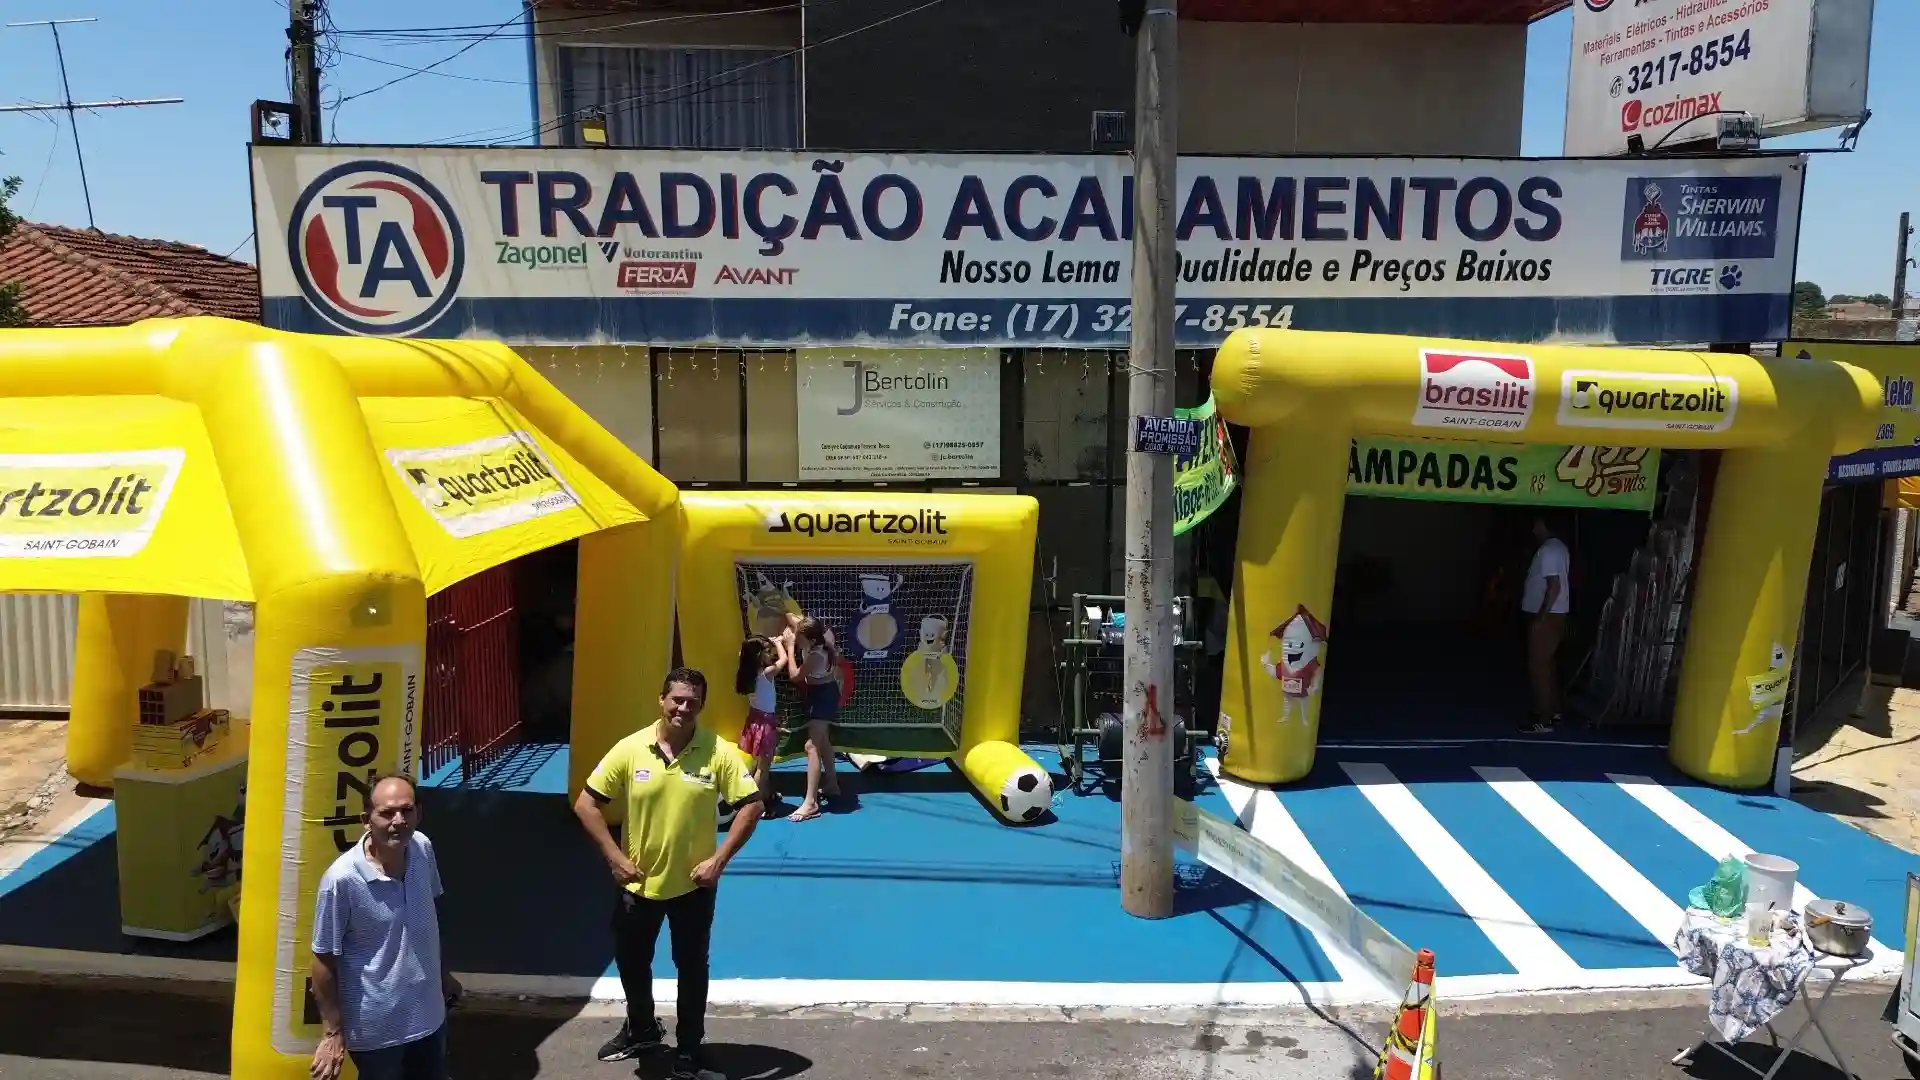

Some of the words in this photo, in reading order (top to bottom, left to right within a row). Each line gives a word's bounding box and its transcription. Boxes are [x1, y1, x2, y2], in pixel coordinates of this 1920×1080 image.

[1583, 32, 1620, 56] Materiais
[1627, 14, 1667, 40] Elétricos
[1600, 37, 1656, 67] Ferramentas
[1665, 24, 1695, 45] Tintas
[1698, 20, 1704, 33] e
[1706, 0, 1769, 32] Acessórios
[1627, 29, 1751, 94] 3217-8554
[1643, 91, 1722, 127] cozimax
[481, 159, 923, 257] TRADIÇÃO
[943, 173, 1563, 242] ACAAMENTOS
[323, 195, 433, 298] TA
[495, 241, 588, 271] Zagonel
[624, 248, 703, 260] Votorantim
[714, 265, 800, 286] AVANT
[940, 250, 1031, 284] Nosso
[1042, 250, 1121, 284] Lema
[1322, 256, 1340, 283] e
[1350, 249, 1446, 291] Preços
[1455, 249, 1552, 283] Baixos
[1651, 268, 1714, 286] TIGRE
[890, 303, 992, 332] Fone:
[1006, 303, 1079, 339] (17)
[1092, 304, 1294, 332] 32-8554
[865, 370, 948, 392] Bertolin
[1426, 377, 1530, 408] brasilit
[1600, 386, 1726, 414] quartzolit
[1145, 418, 1195, 434] AVENIDA
[1442, 416, 1522, 429] SAINT-GOBAIN
[1140, 430, 1198, 446] PROMISSÃO
[438, 450, 553, 507] quartzolit
[794, 508, 947, 538] quartzolit
[24, 539, 120, 551] SAINT-GOBAIN
